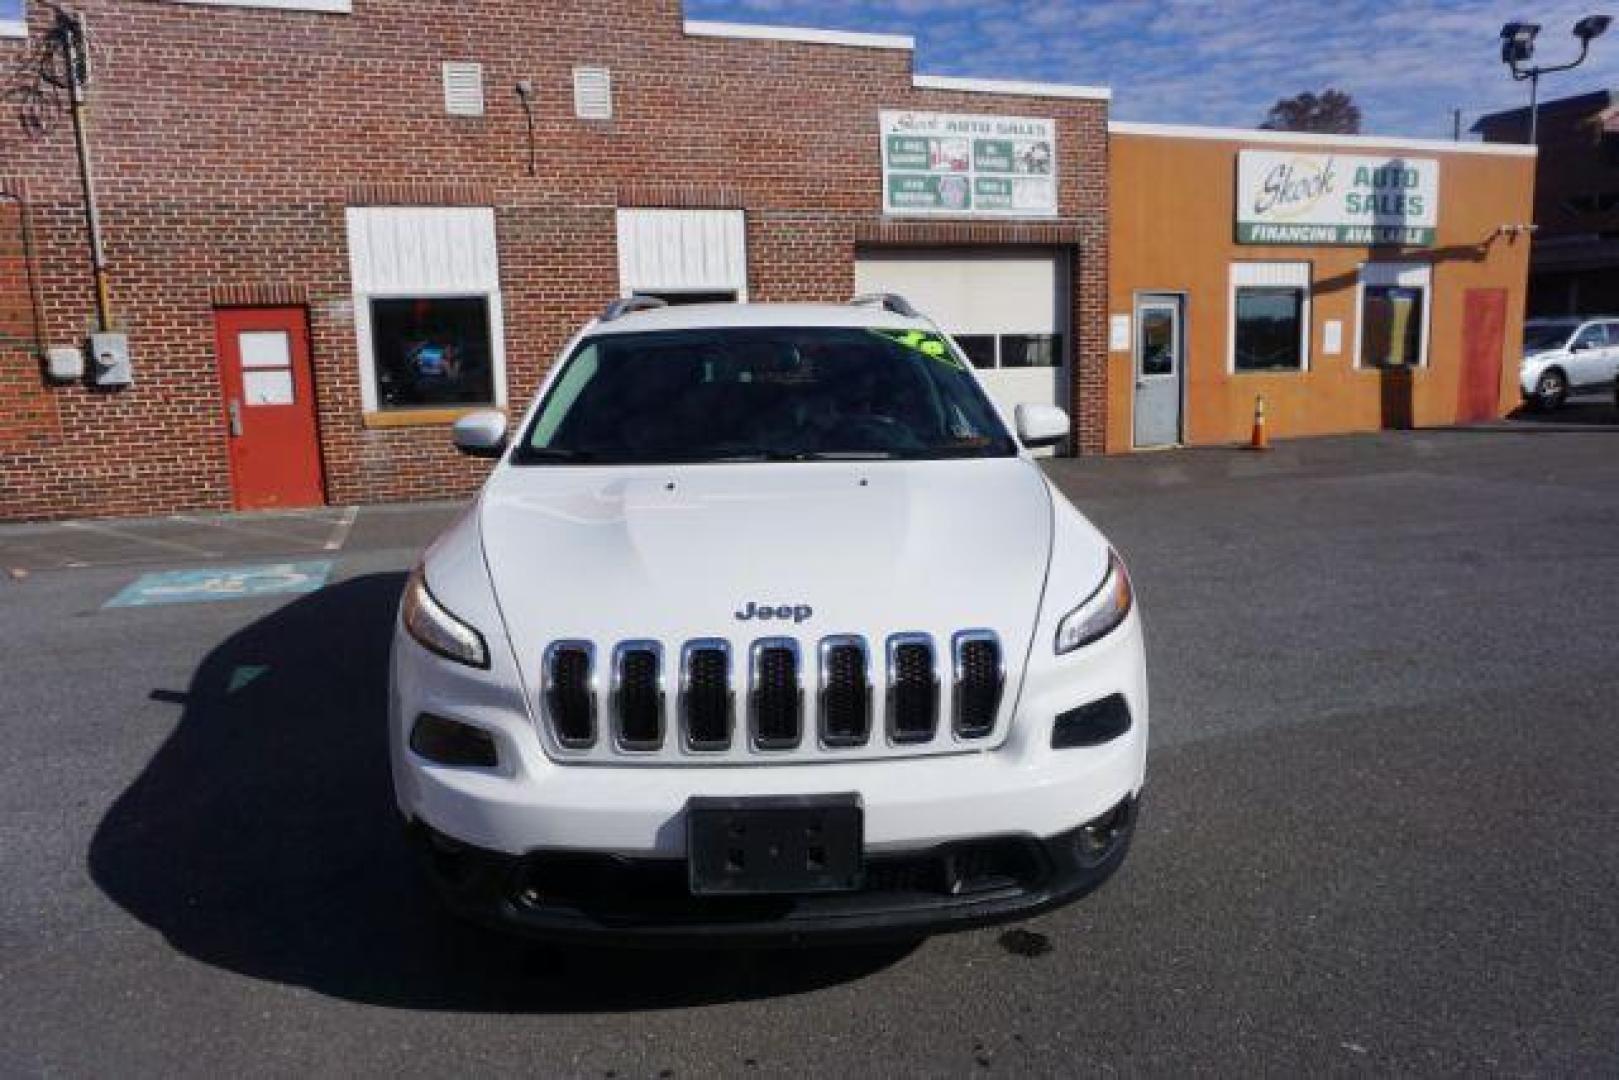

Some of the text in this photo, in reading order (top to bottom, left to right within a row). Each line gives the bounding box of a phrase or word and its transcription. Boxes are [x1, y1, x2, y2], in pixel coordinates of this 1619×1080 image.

[946, 119, 991, 132] AUTO
[997, 122, 1046, 136] SALES
[1353, 166, 1420, 188] AUTO
[1345, 192, 1425, 216] SALES
[1251, 223, 1337, 244] FINANCING
[734, 601, 813, 623] Jeep
